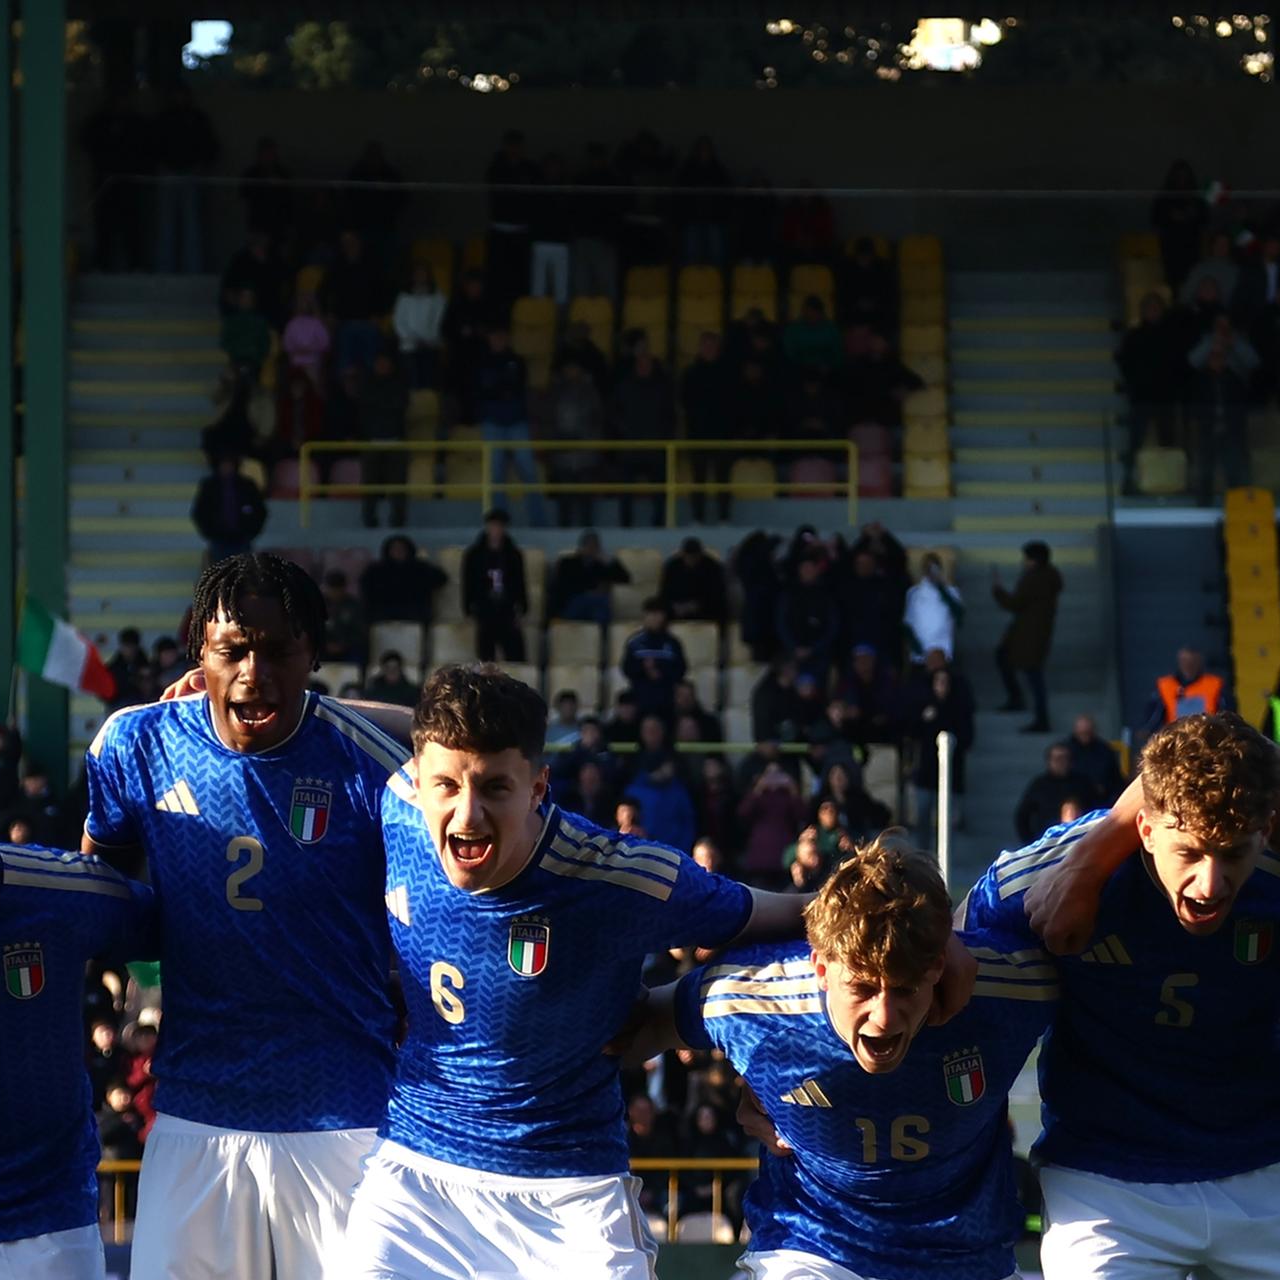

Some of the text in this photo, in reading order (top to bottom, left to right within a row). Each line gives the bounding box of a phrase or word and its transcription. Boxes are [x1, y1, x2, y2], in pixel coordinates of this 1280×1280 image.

[295, 787, 328, 803] ITALIA
[225, 835, 264, 912] 2
[512, 924, 548, 940] ITALIA
[6, 952, 41, 966] ITALIA
[429, 960, 465, 1024] 6
[1153, 971, 1200, 1029] 5
[948, 1058, 980, 1076] ITALIA
[854, 1115, 931, 1164] 16
